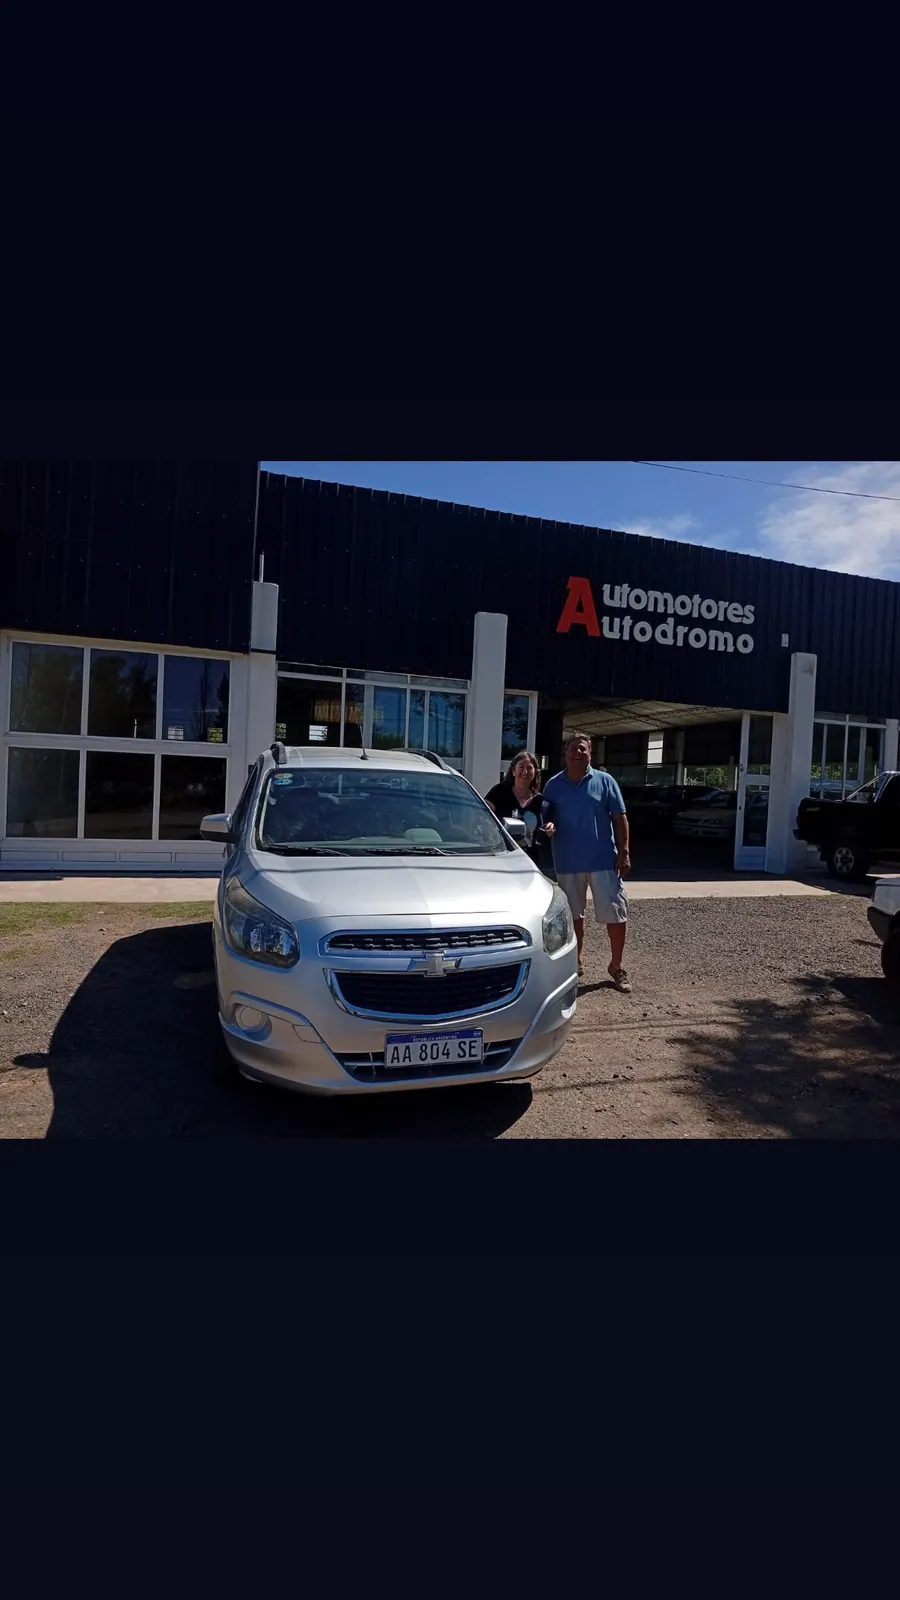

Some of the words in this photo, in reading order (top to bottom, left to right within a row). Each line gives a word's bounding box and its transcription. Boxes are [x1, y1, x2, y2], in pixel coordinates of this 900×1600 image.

[390, 1045, 412, 1064] AA
[419, 1042, 451, 1062] 804
[457, 1040, 478, 1059] SE
